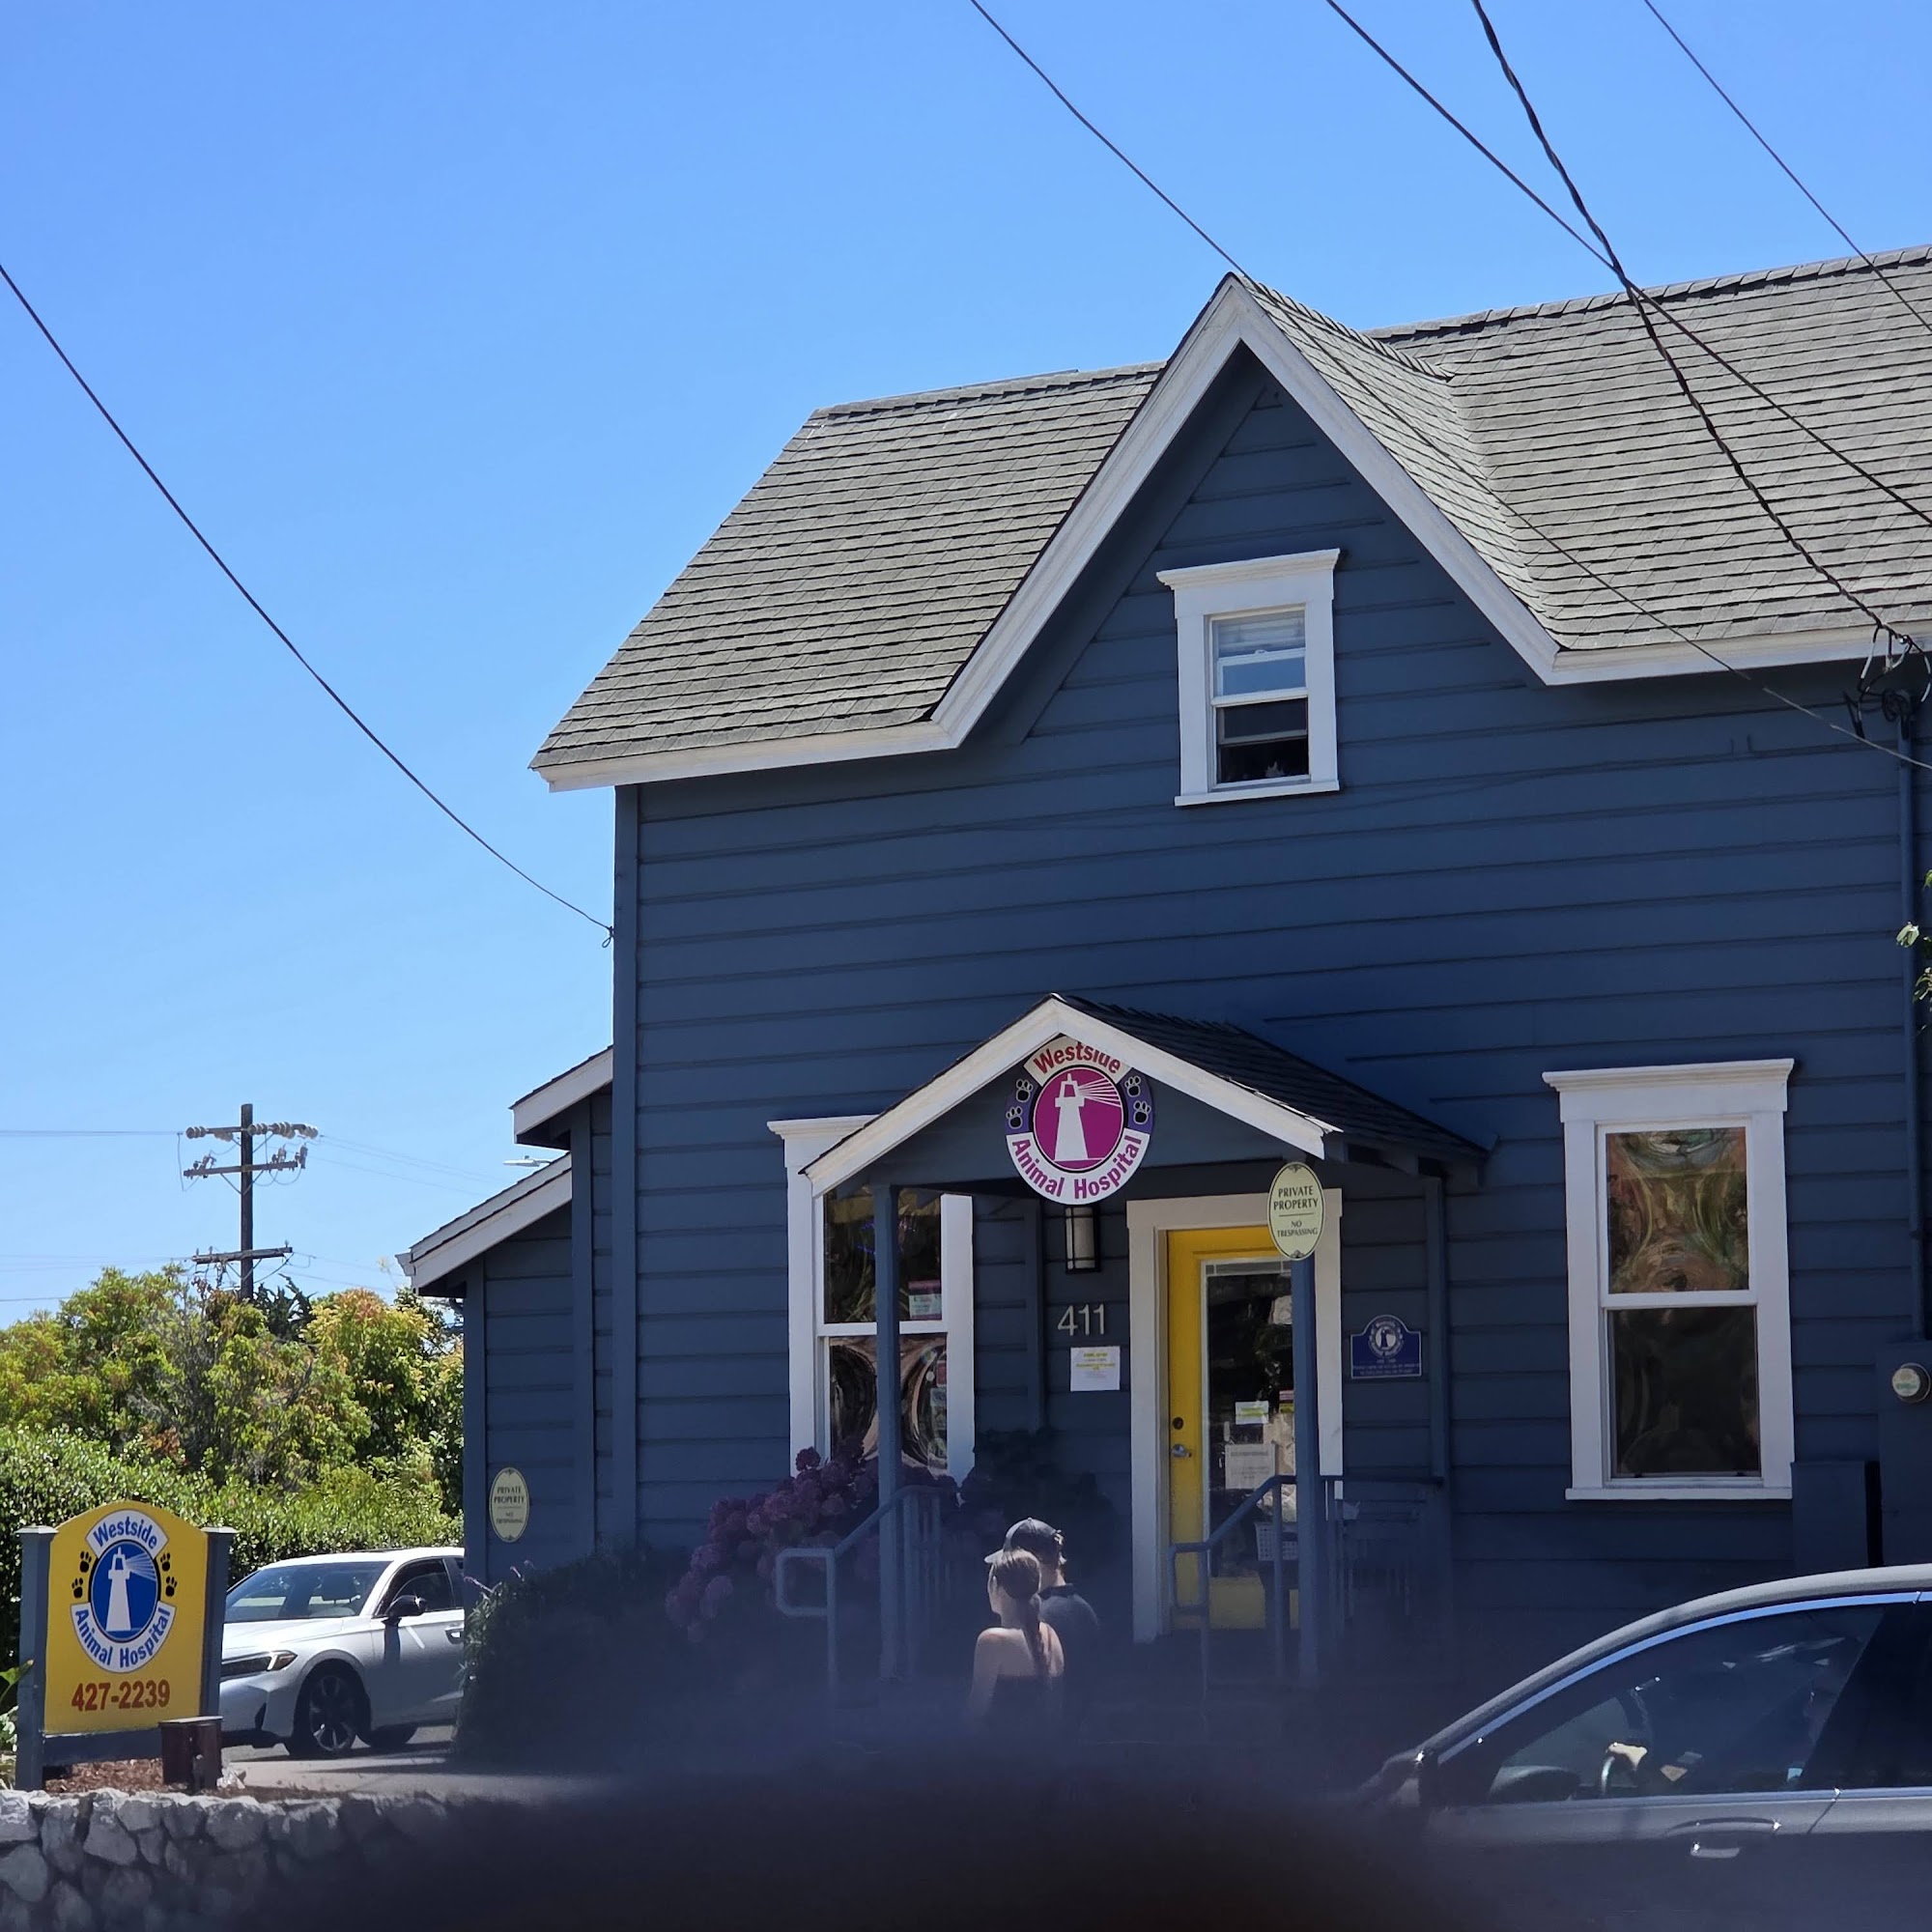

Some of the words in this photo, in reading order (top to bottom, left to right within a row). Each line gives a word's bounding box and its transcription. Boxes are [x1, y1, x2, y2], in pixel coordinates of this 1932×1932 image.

[1012, 1139, 1065, 1197] Animal
[1074, 1135, 1143, 1199] Hospital
[1273, 1198, 1319, 1210] PROPERTY
[1278, 1185, 1314, 1198] PRIVATE
[1277, 1228, 1319, 1237] TRESPASSING
[1057, 1303, 1105, 1337] 411
[93, 1517, 157, 1549] Westside
[74, 1609, 113, 1666] Animal
[120, 1607, 171, 1668] Hospital
[71, 1679, 171, 1712] 427-2239
